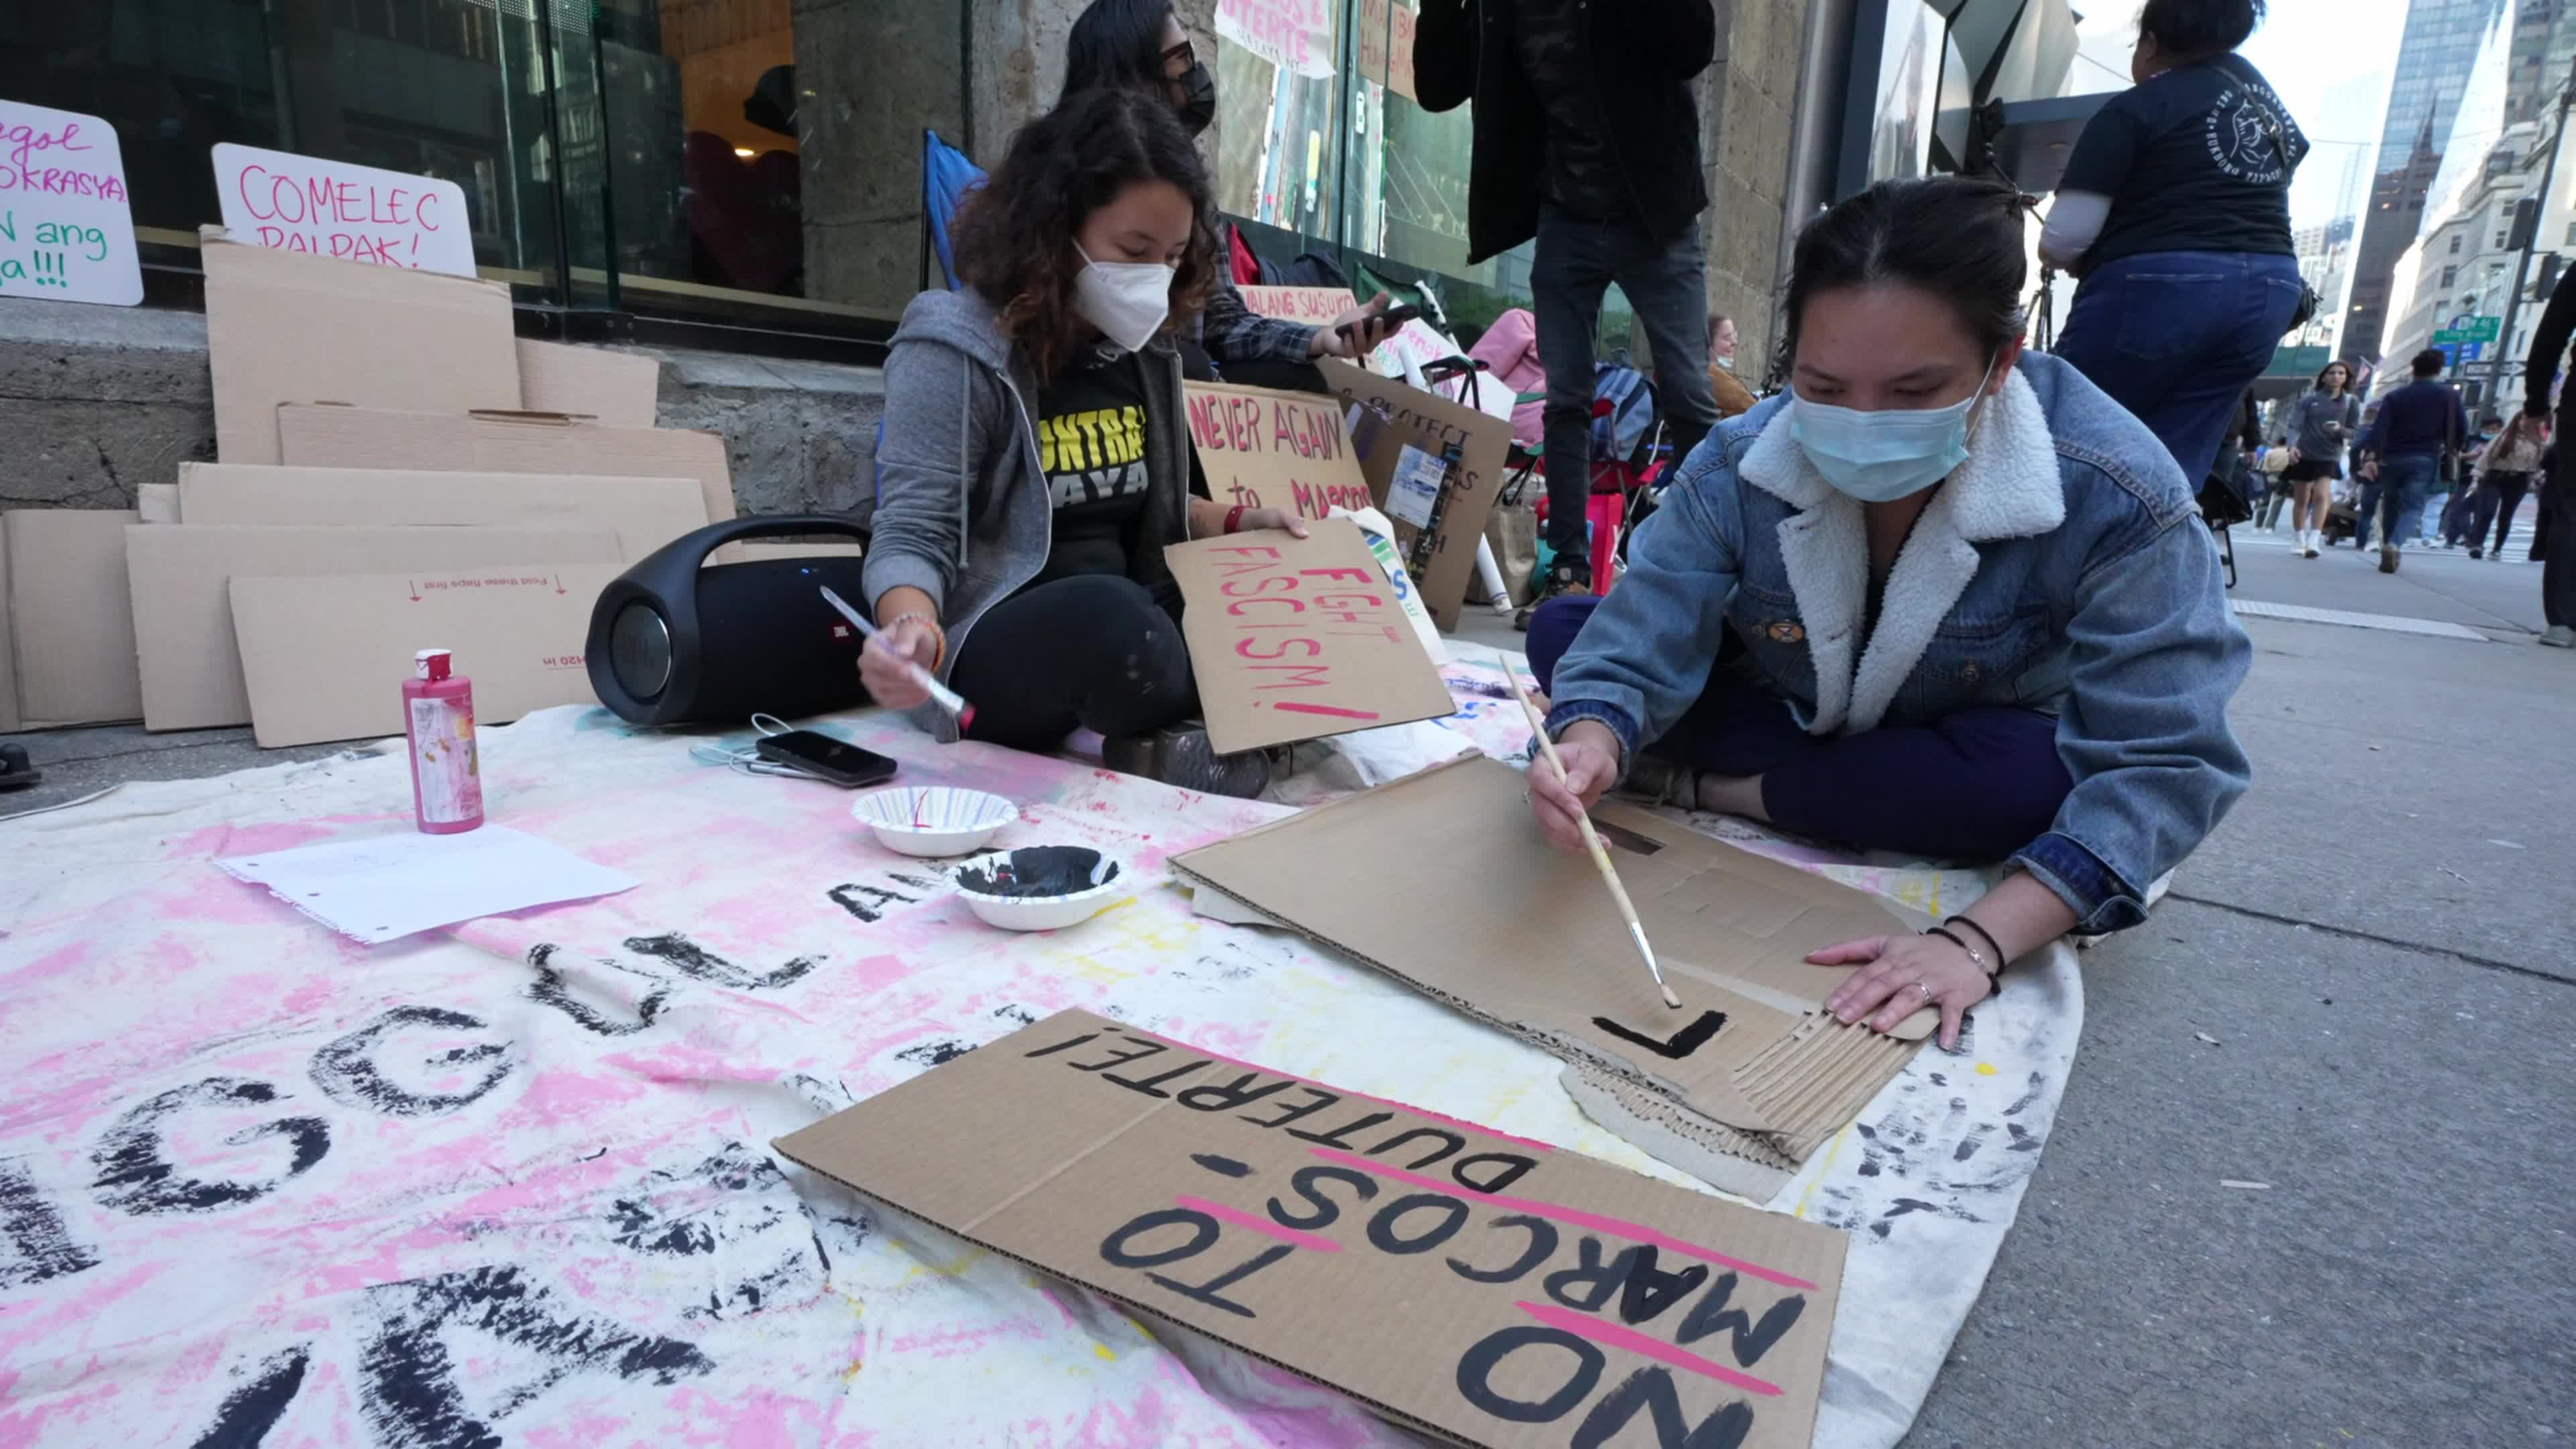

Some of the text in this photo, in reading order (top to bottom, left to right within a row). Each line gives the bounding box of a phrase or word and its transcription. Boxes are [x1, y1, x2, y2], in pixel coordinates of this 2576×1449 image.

[240, 164, 439, 231] COMELEC
[36, 222, 107, 262] ang
[1246, 289, 1295, 317] ALANG
[1189, 394, 1342, 461] NEVER AGAIN
[1051, 460, 1148, 508] AYA
[1226, 475, 1261, 509] to
[423, 581, 448, 590] first
[451, 579, 481, 588] flaps
[484, 578, 519, 586] these
[1299, 568, 1403, 643] FIGHT
[1208, 547, 1380, 720] FASCISM!
[1024, 1026, 1542, 1195] DUTERTE!
[1099, 1208, 1755, 1449] NO TO
